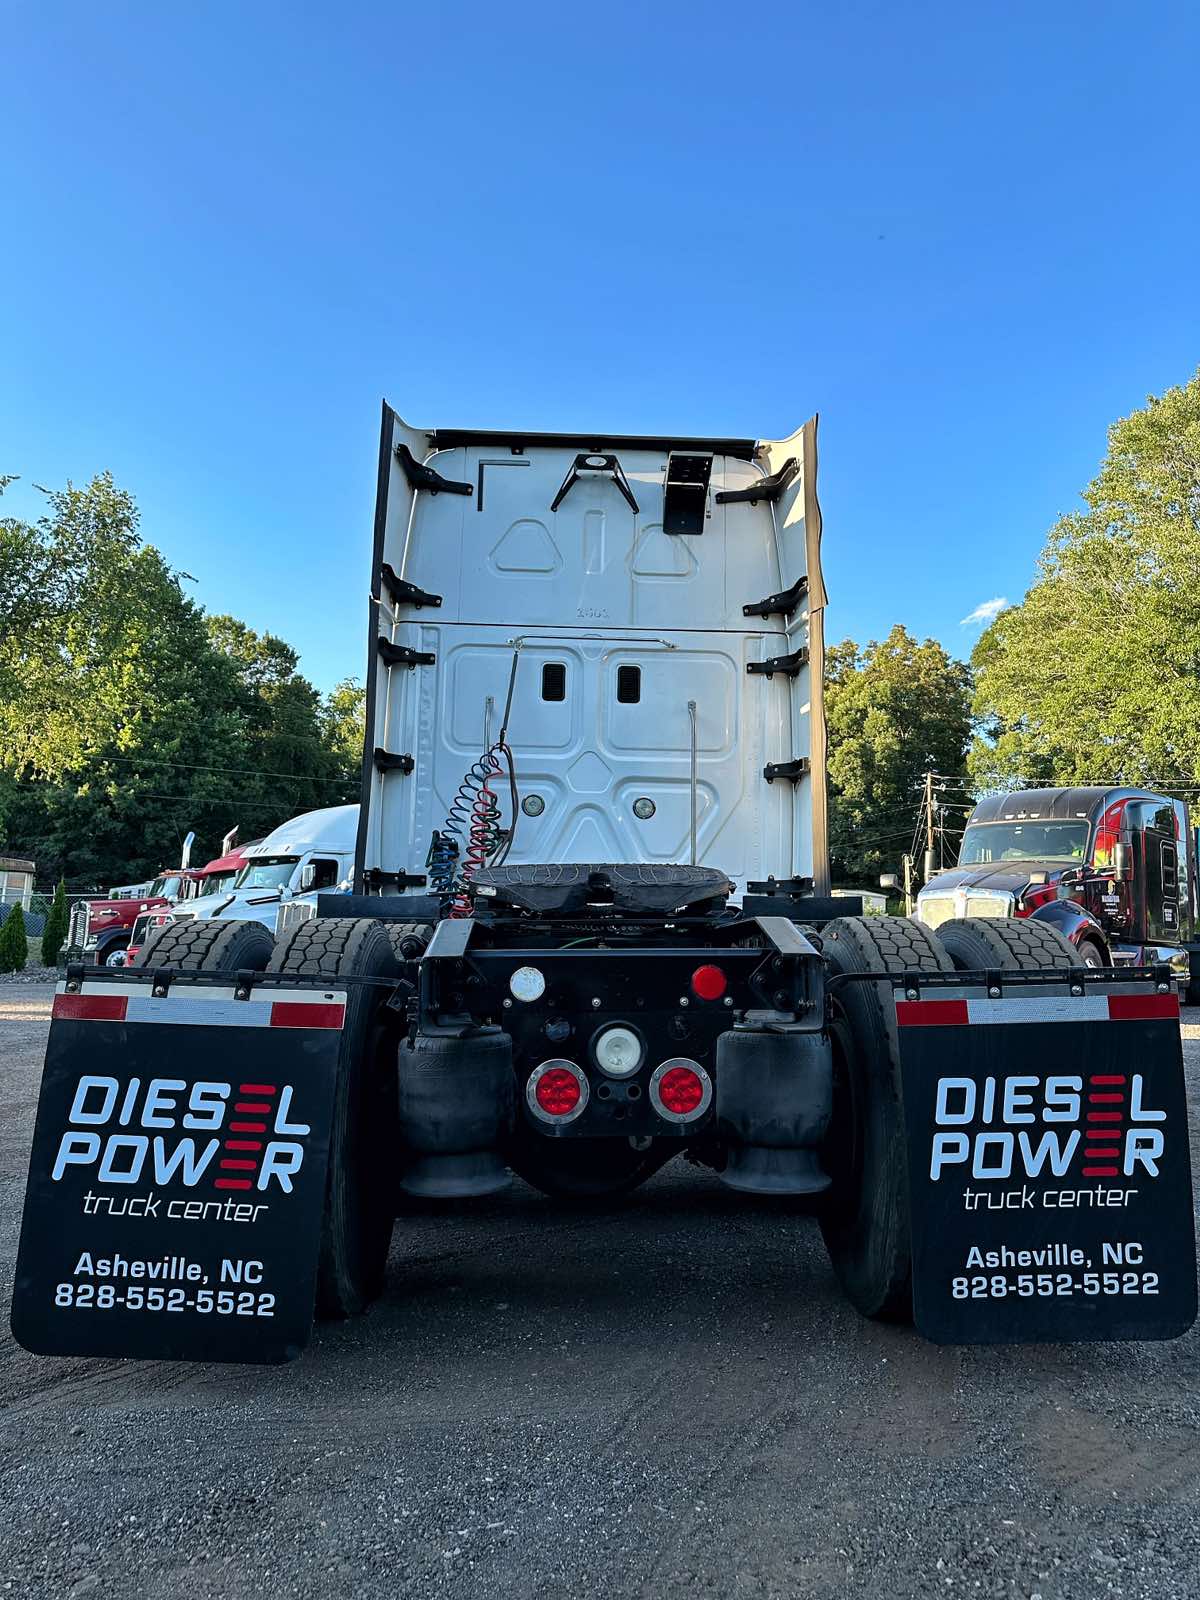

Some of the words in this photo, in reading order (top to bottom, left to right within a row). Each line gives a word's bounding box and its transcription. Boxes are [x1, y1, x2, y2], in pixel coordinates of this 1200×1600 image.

[69, 1076, 310, 1135] DIESEL
[935, 1074, 1167, 1124] DIESEL
[52, 1131, 303, 1193] POWER
[930, 1129, 1164, 1180] POWER
[83, 1190, 161, 1217] truck
[167, 1198, 268, 1222] center
[963, 1185, 1035, 1209] truck
[1043, 1185, 1138, 1207] center
[74, 1253, 208, 1284] Asheville,
[221, 1260, 263, 1283] NC
[966, 1244, 1092, 1268] Asheville,
[1103, 1243, 1143, 1264] NC
[55, 1284, 275, 1316] 828-552-5522
[953, 1273, 1159, 1298] 828-552-5522
